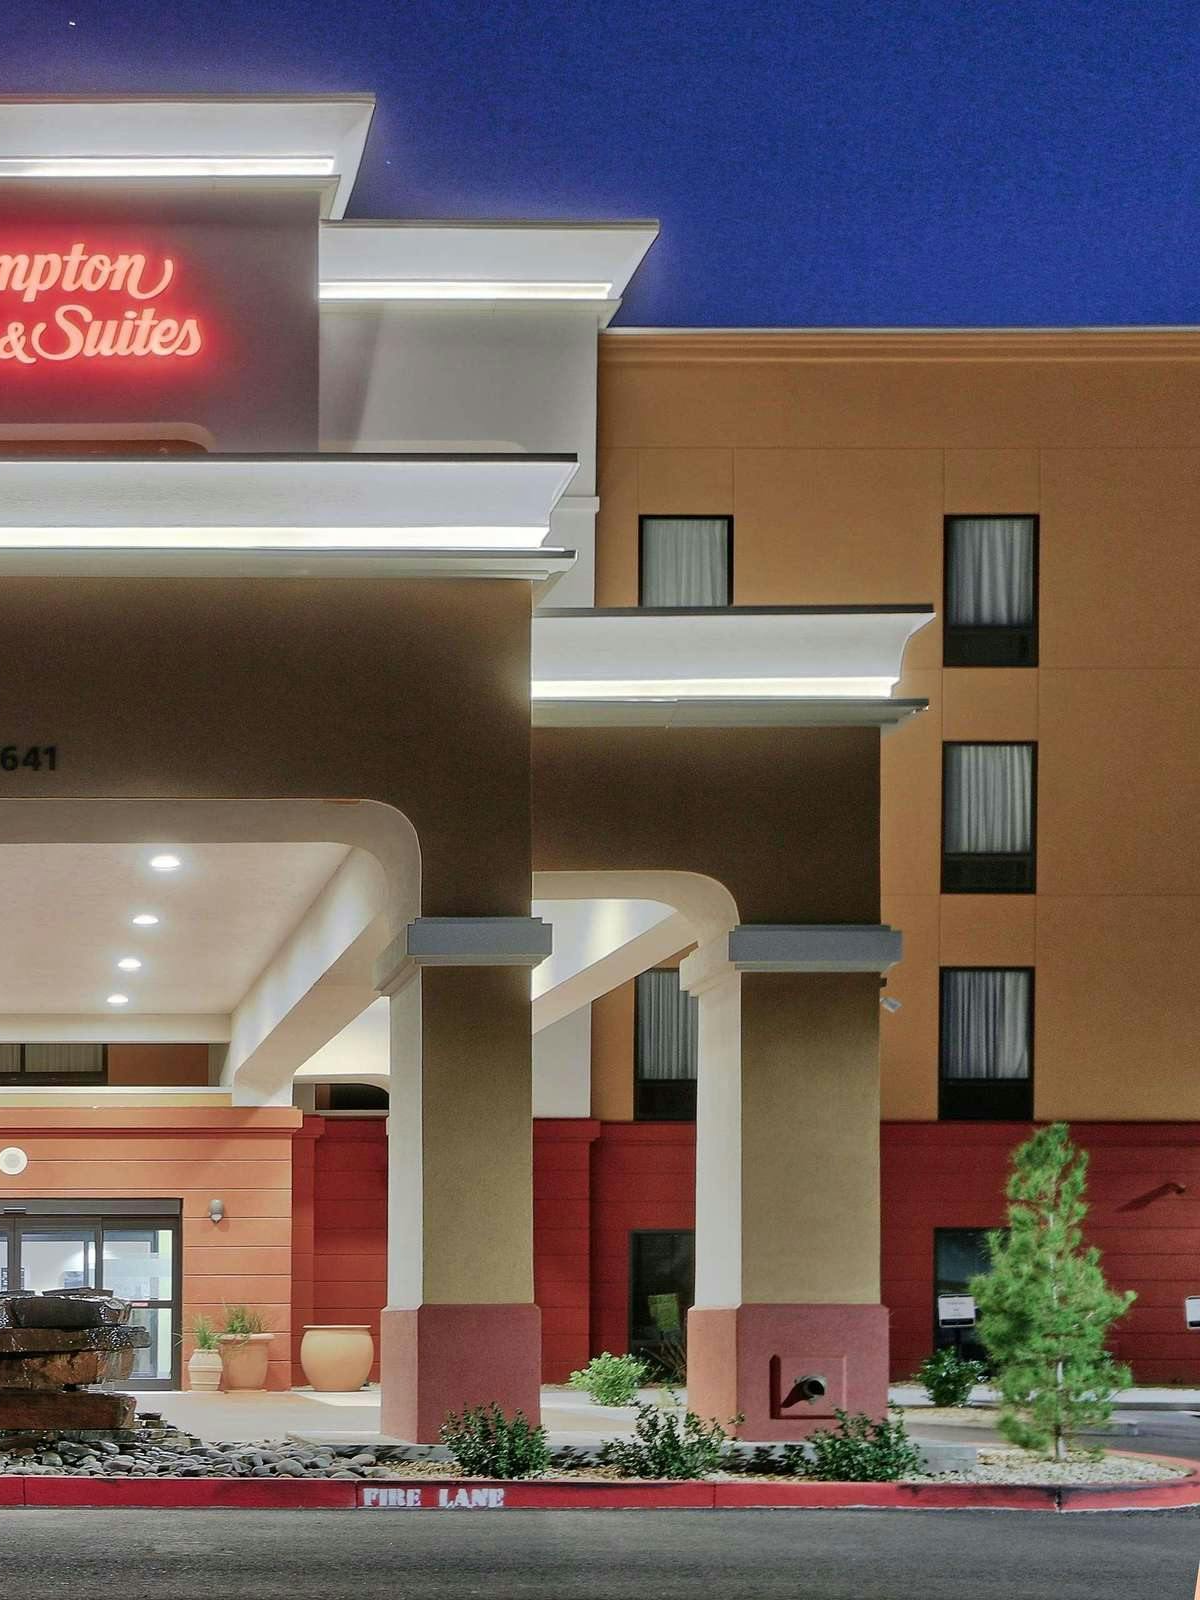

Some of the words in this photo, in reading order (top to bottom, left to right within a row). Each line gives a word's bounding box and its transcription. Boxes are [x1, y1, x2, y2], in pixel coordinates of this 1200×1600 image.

[31, 304, 202, 361] Suites
[363, 1488, 422, 1507] FIRE
[439, 1488, 505, 1508] LANE
